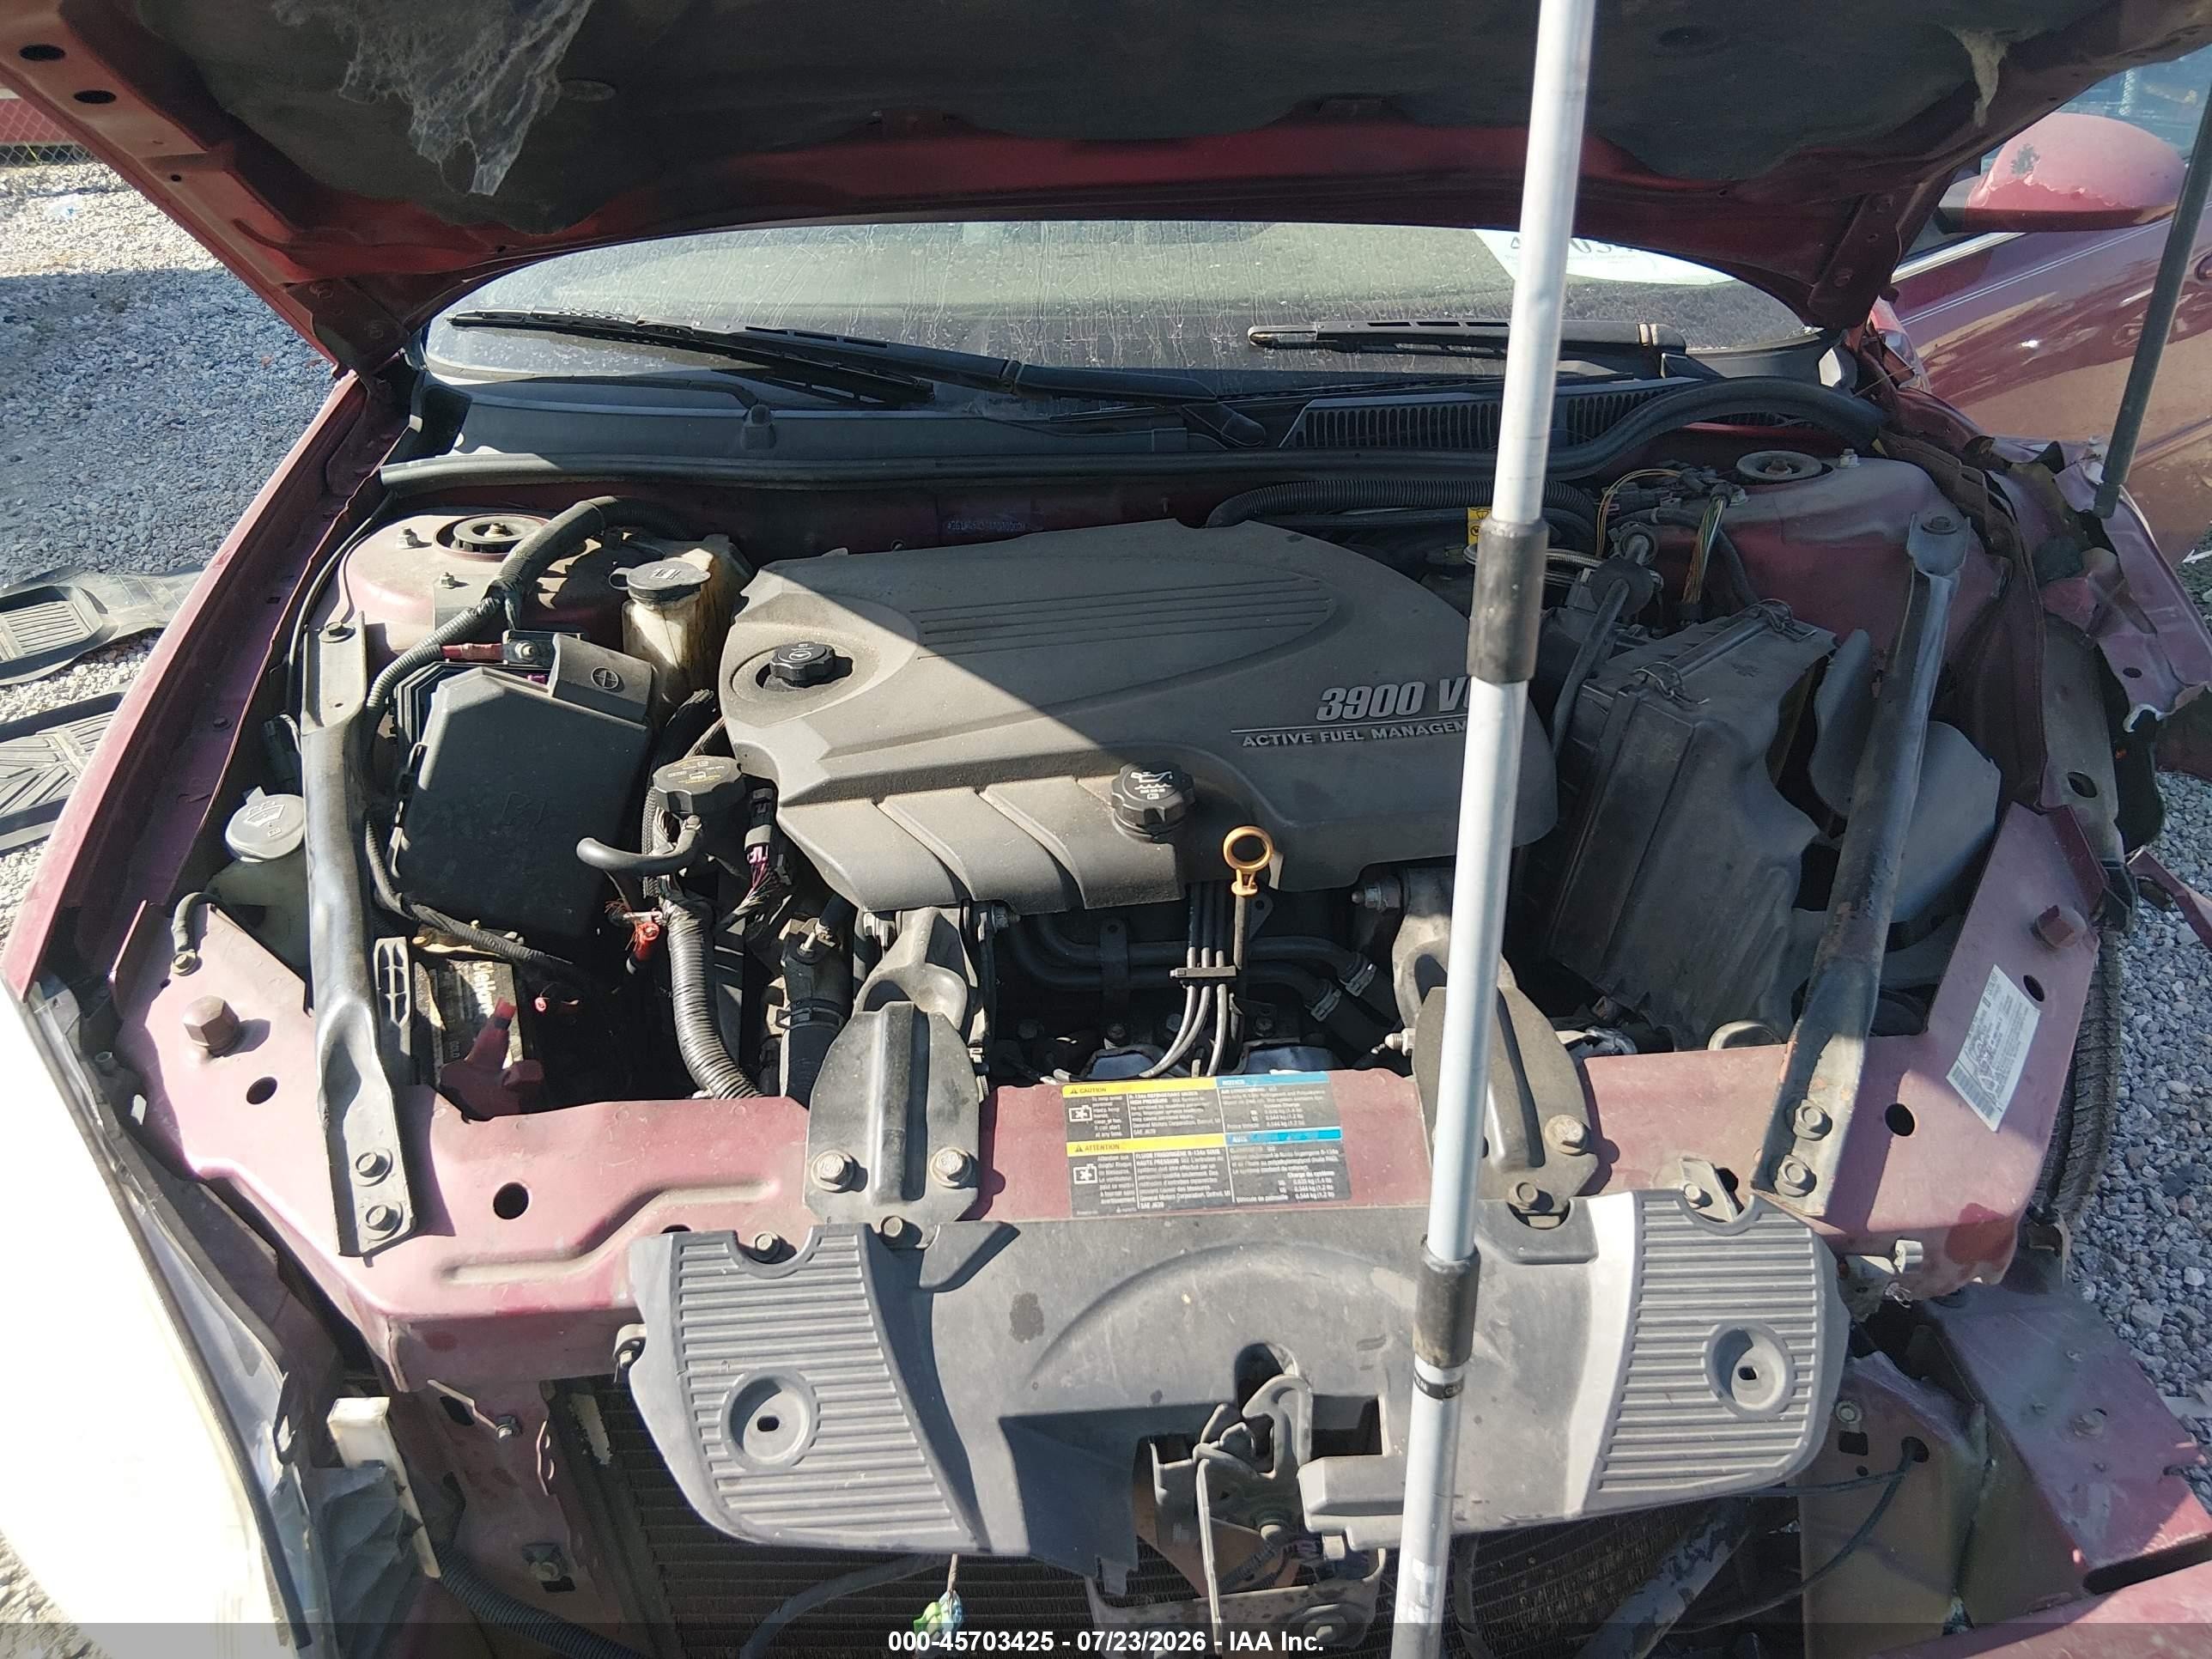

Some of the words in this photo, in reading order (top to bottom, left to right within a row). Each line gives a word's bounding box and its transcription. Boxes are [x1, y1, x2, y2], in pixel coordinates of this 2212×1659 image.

[1316, 681, 1425, 721] 3900
[1243, 732, 1313, 747] ACTIVE
[1320, 730, 1364, 743] FUEL
[1370, 720, 1468, 739] MANAGEM
